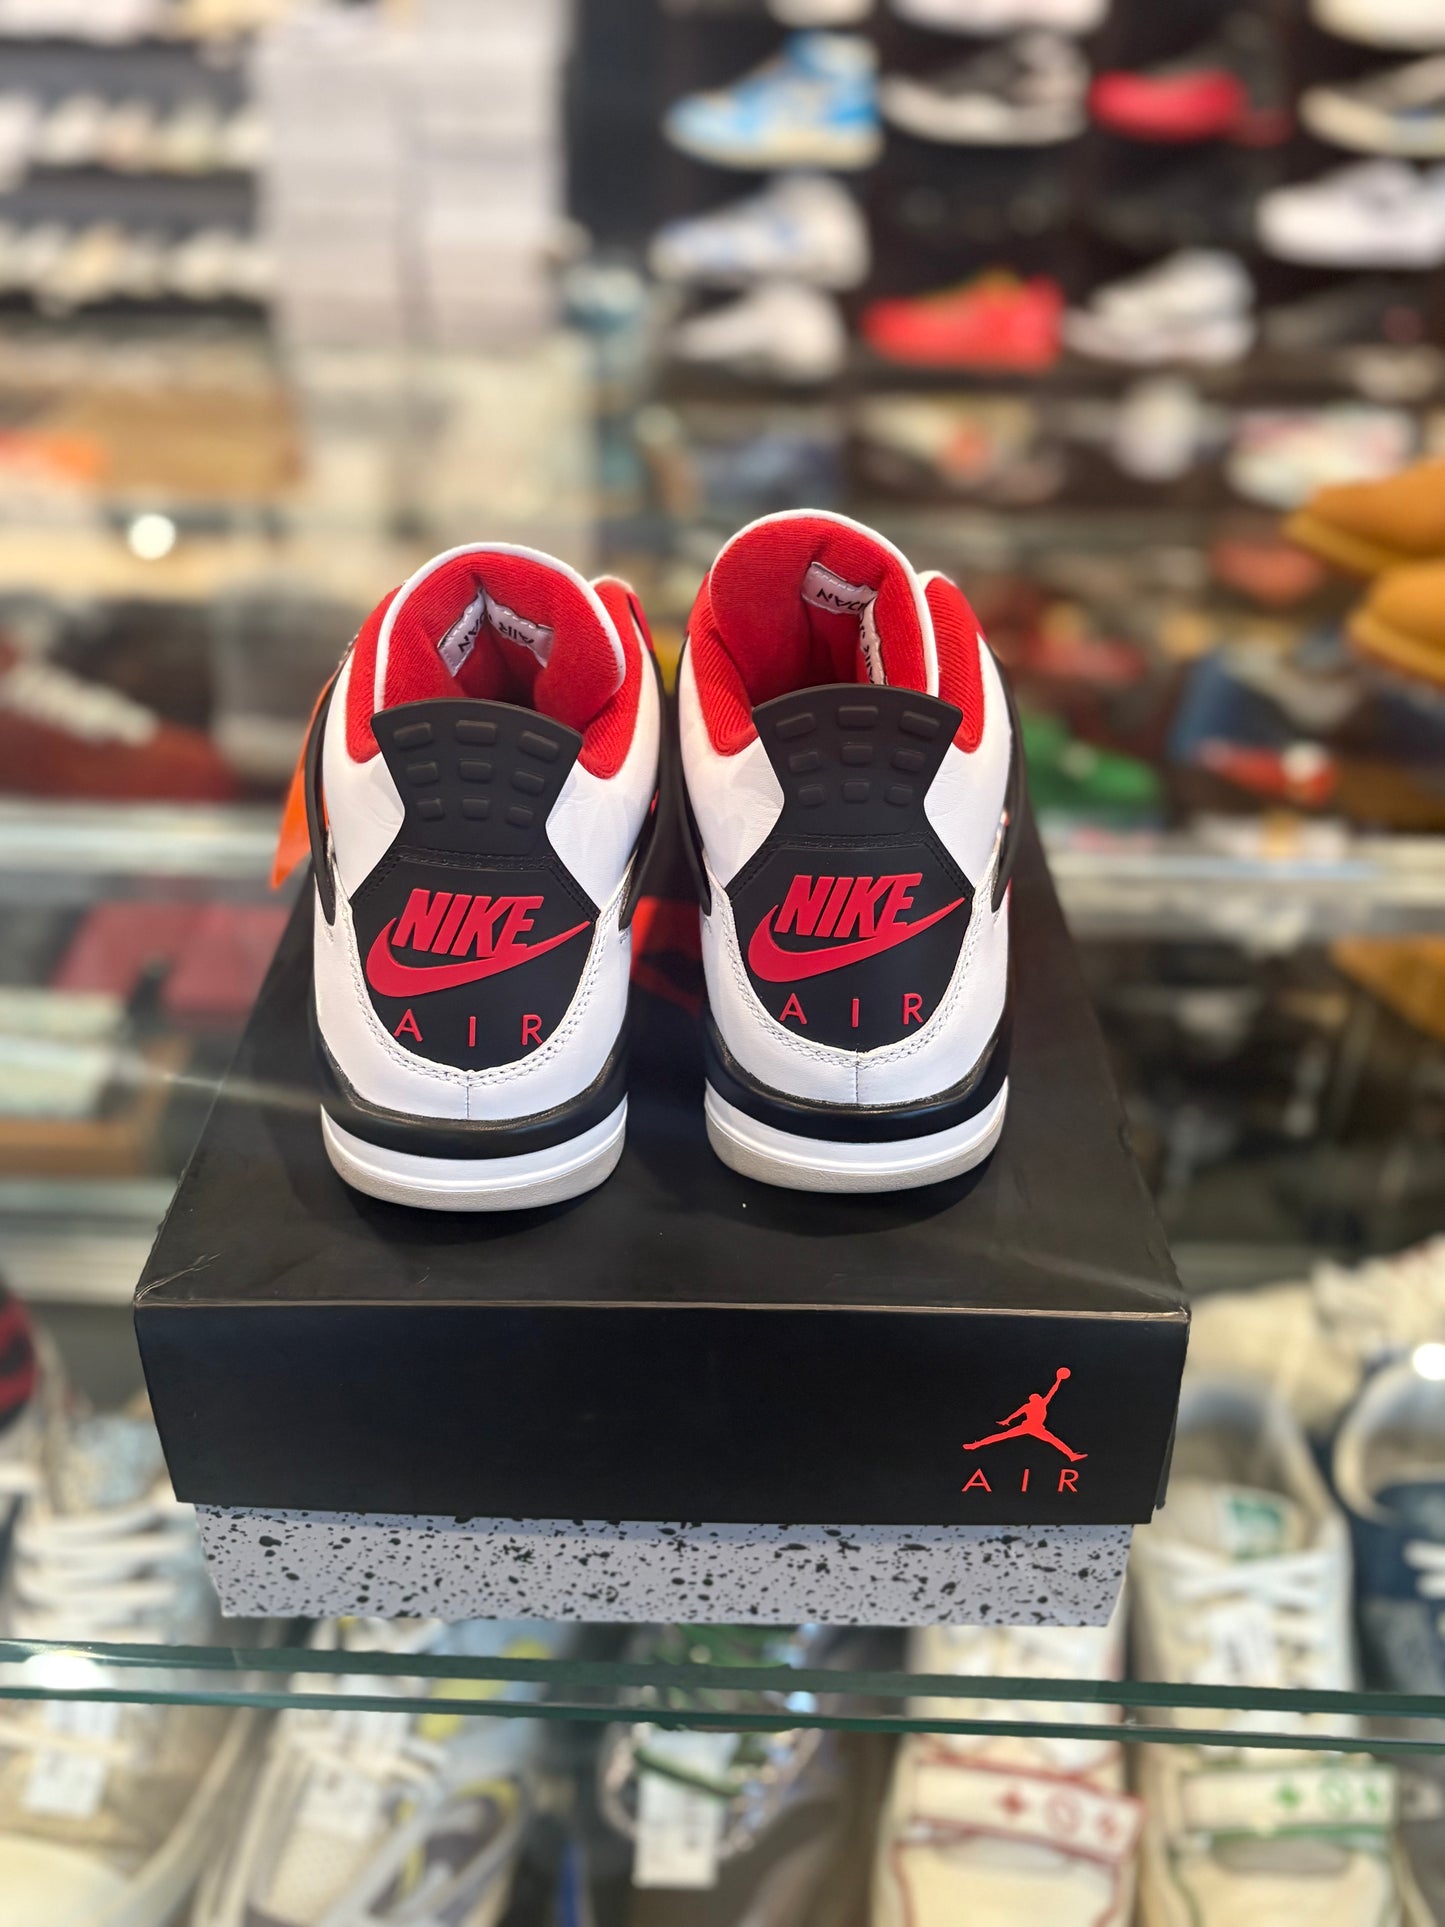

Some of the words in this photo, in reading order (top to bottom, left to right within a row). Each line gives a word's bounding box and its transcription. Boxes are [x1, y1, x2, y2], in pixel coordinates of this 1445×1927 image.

[498, 622, 535, 645] AIR
[391, 888, 544, 958] NIKE
[773, 872, 923, 938] NIKE
[394, 1008, 543, 1048] AIR
[779, 993, 924, 1028] AIR
[961, 1468, 1079, 1493] AIR
